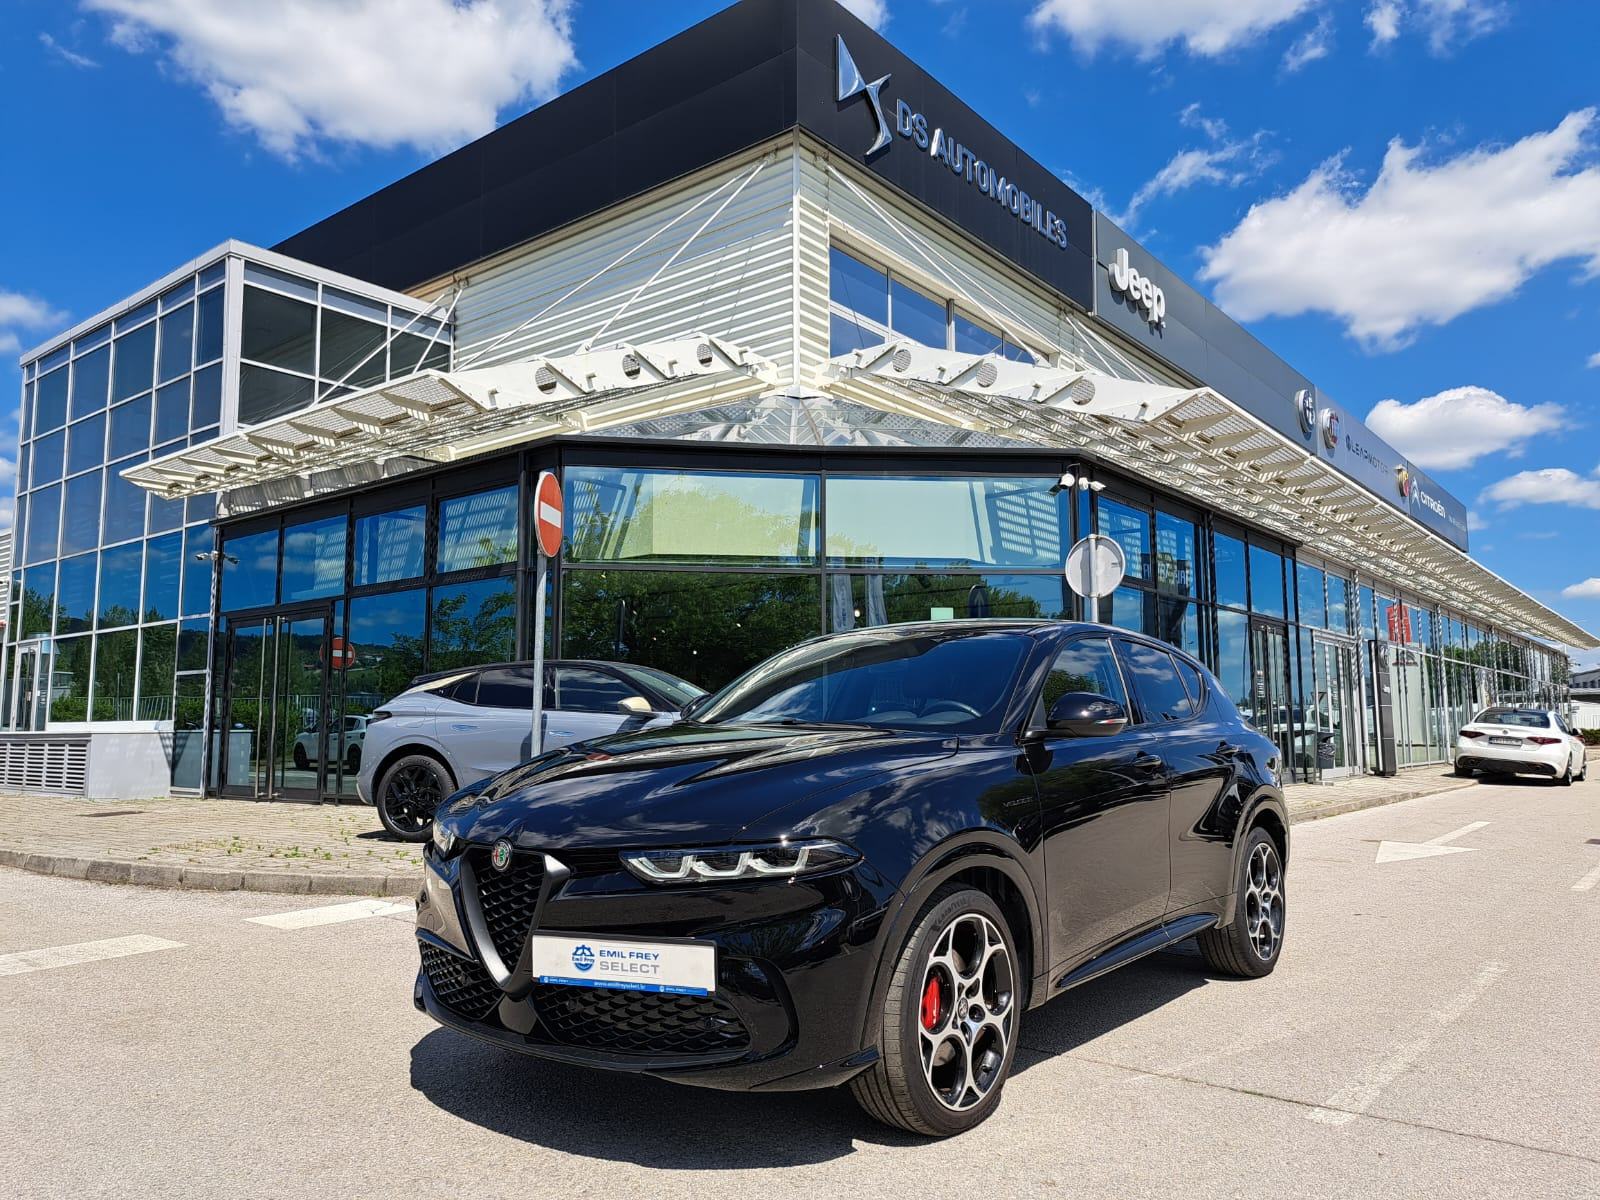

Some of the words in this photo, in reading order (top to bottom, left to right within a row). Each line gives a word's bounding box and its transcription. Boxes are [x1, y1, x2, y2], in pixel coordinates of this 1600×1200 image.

[896, 98, 928, 150] DS
[930, 128, 1068, 250] AUTOMOBILES
[1109, 248, 1167, 325] Jeep
[599, 949, 627, 959] EMIL
[629, 951, 660, 961] FREY
[599, 961, 660, 975] SELECT
